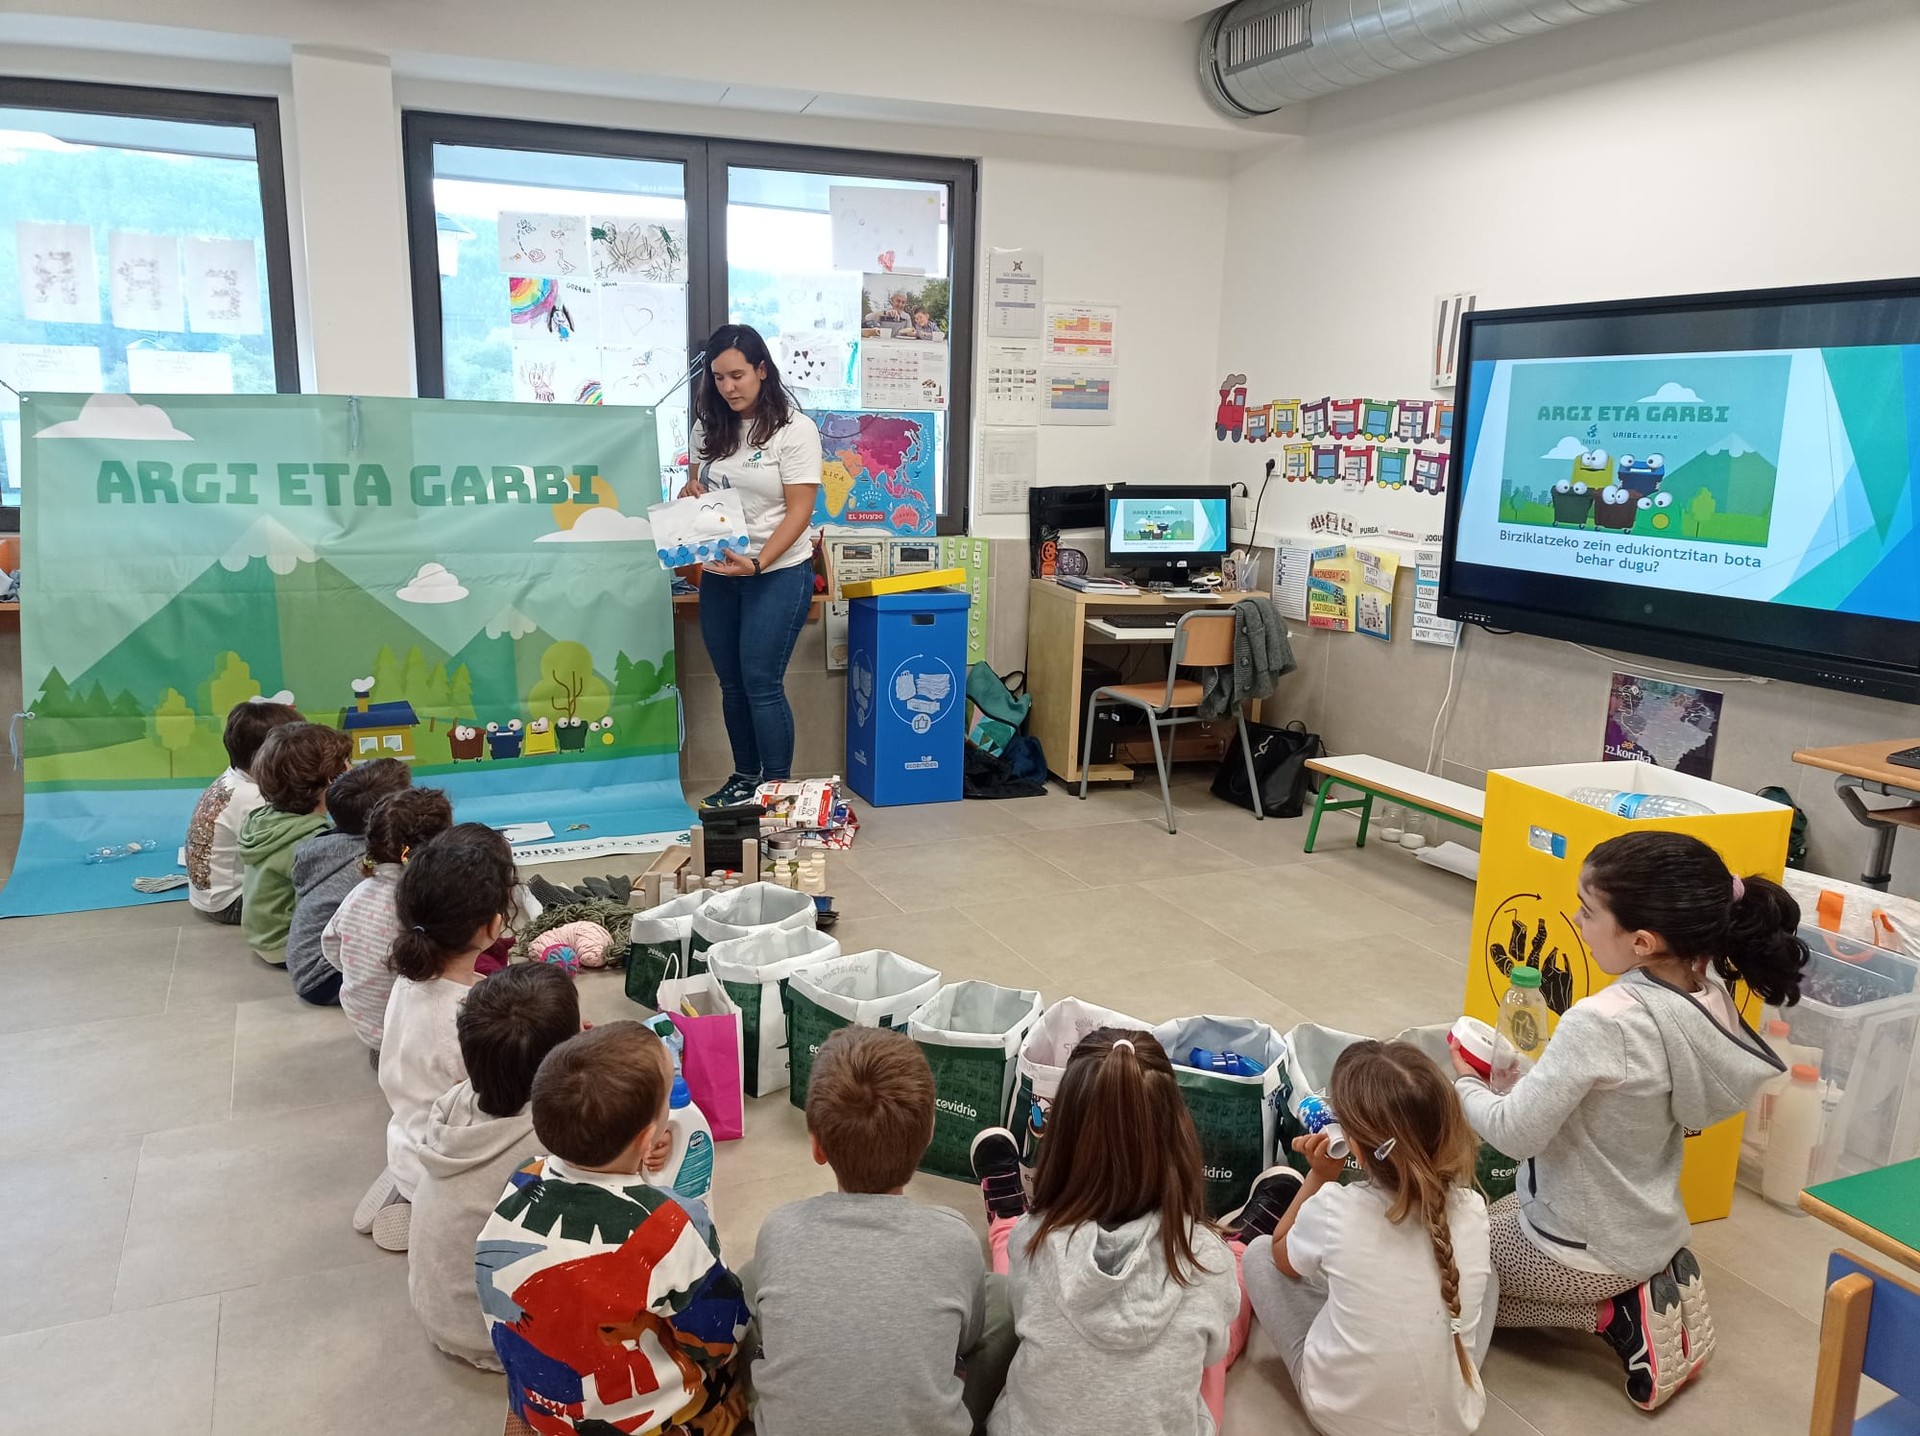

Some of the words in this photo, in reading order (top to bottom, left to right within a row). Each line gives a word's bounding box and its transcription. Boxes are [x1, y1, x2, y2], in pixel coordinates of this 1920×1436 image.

[1538, 406, 1592, 421] ARGI
[1598, 406, 1640, 421] ETA
[1646, 406, 1729, 423] GARBI
[97, 460, 258, 505] ARGI
[277, 462, 392, 507] ETA
[410, 465, 599, 507] GARBI
[1315, 549, 1333, 558] MONDAY
[1499, 530, 1579, 549] Birziklatzeko
[1583, 540, 1611, 552] zein
[1616, 543, 1718, 564] edukiontzitan
[1724, 554, 1762, 568] bota
[1575, 552, 1615, 567] behar
[1619, 558, 1660, 573] dugu?
[1420, 569, 1438, 579] PARTLY
[1311, 593, 1329, 602] FRIDAY
[1312, 603, 1336, 613] SATURDAY
[1415, 629, 1430, 638] WINDY
[935, 1098, 977, 1118] covidrio
[1202, 1165, 1233, 1179] idrio
